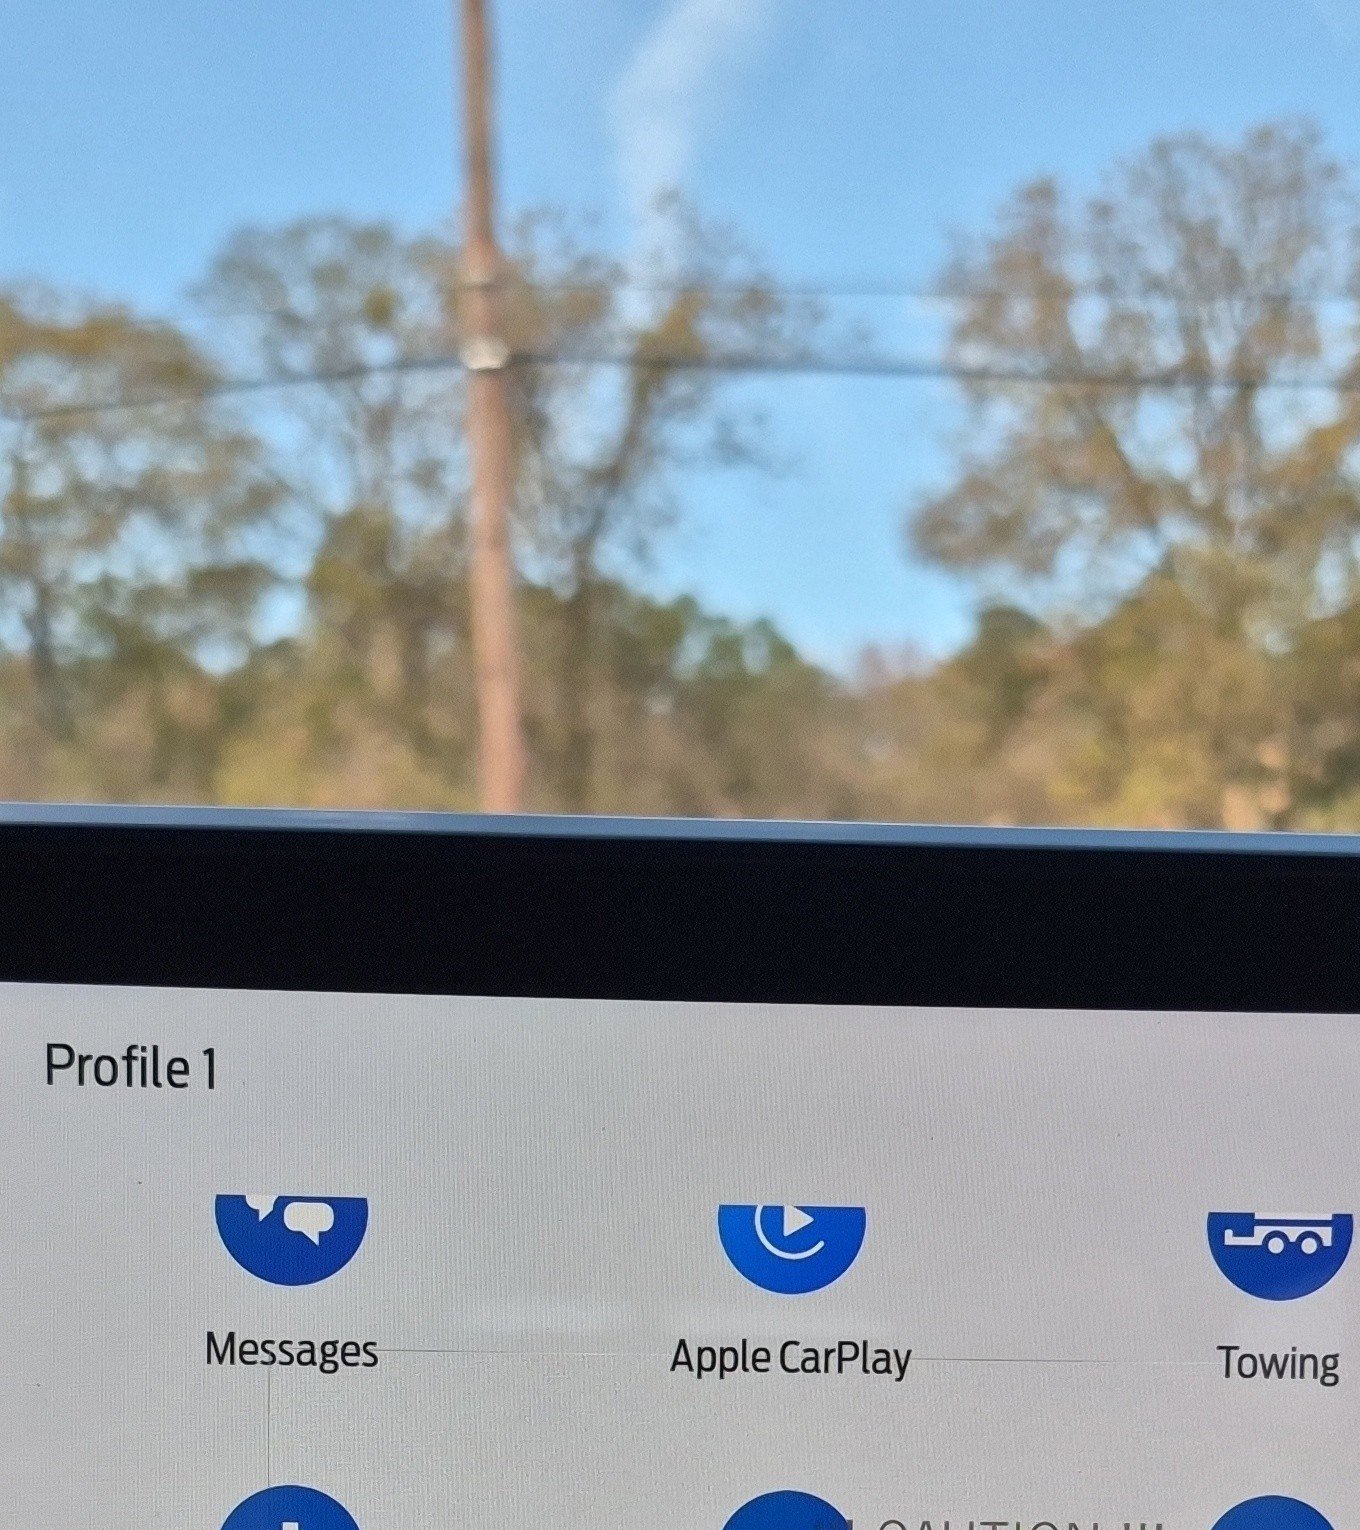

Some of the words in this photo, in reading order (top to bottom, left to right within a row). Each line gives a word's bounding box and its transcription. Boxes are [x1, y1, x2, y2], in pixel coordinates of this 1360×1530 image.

[46, 1043, 189, 1089] Profile
[203, 1048, 214, 1089] 1
[207, 1331, 378, 1374] Messages
[670, 1338, 771, 1380] Apple
[780, 1340, 912, 1382] CarPlay
[1216, 1345, 1339, 1387] Towing
